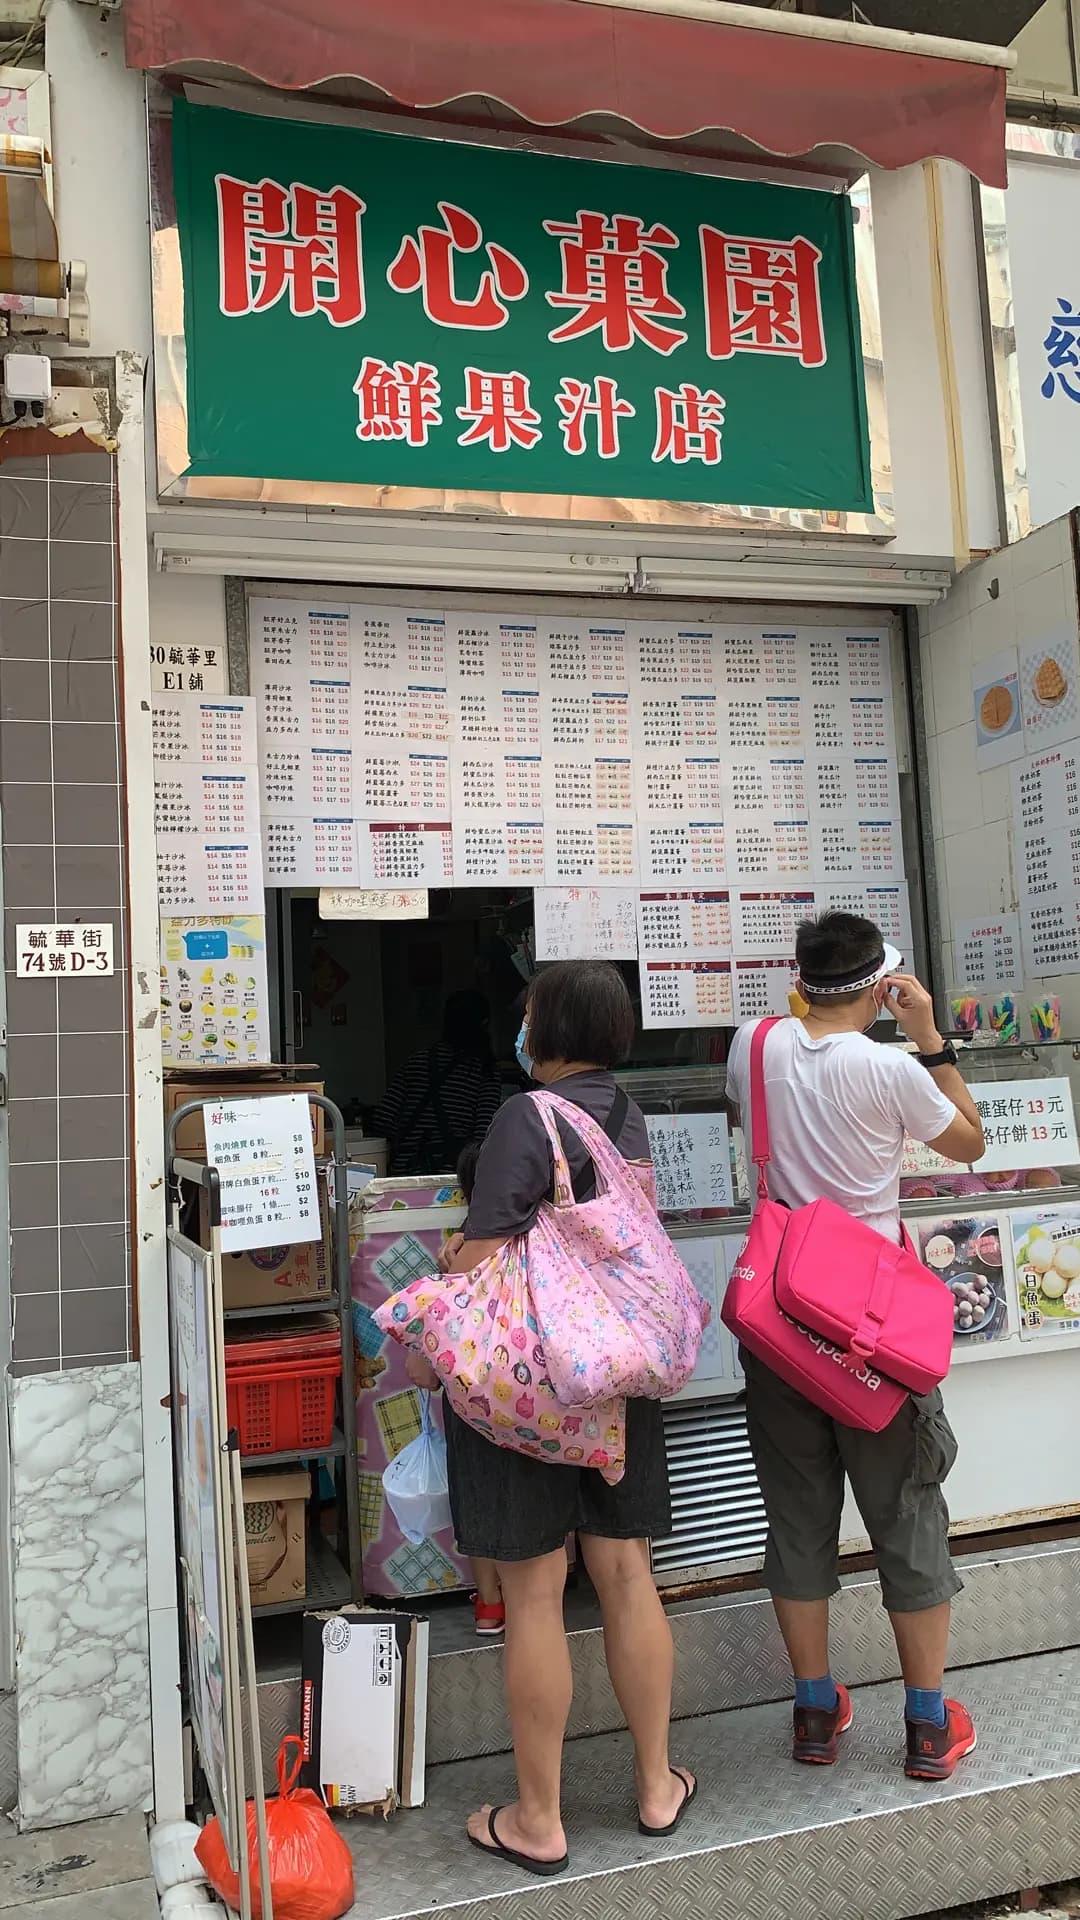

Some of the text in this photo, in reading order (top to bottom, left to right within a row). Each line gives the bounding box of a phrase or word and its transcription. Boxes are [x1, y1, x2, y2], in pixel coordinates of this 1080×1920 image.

[214, 173, 830, 369] 開心菓園
[354, 355, 727, 465] 鮮果汁店
[28, 930, 102, 948] 毓華街
[1027, 1100, 1045, 1114] 13
[1047, 1095, 1065, 1114] 元
[1032, 1126, 1048, 1140] 13
[1051, 1121, 1068, 1141] 元
[294, 1147, 304, 1155] $8
[295, 1171, 310, 1180] $10
[296, 1184, 311, 1193] $20
[298, 1197, 309, 1205] $2
[299, 1209, 309, 1218] $8
[302, 1686, 312, 1756] NAARMANN
